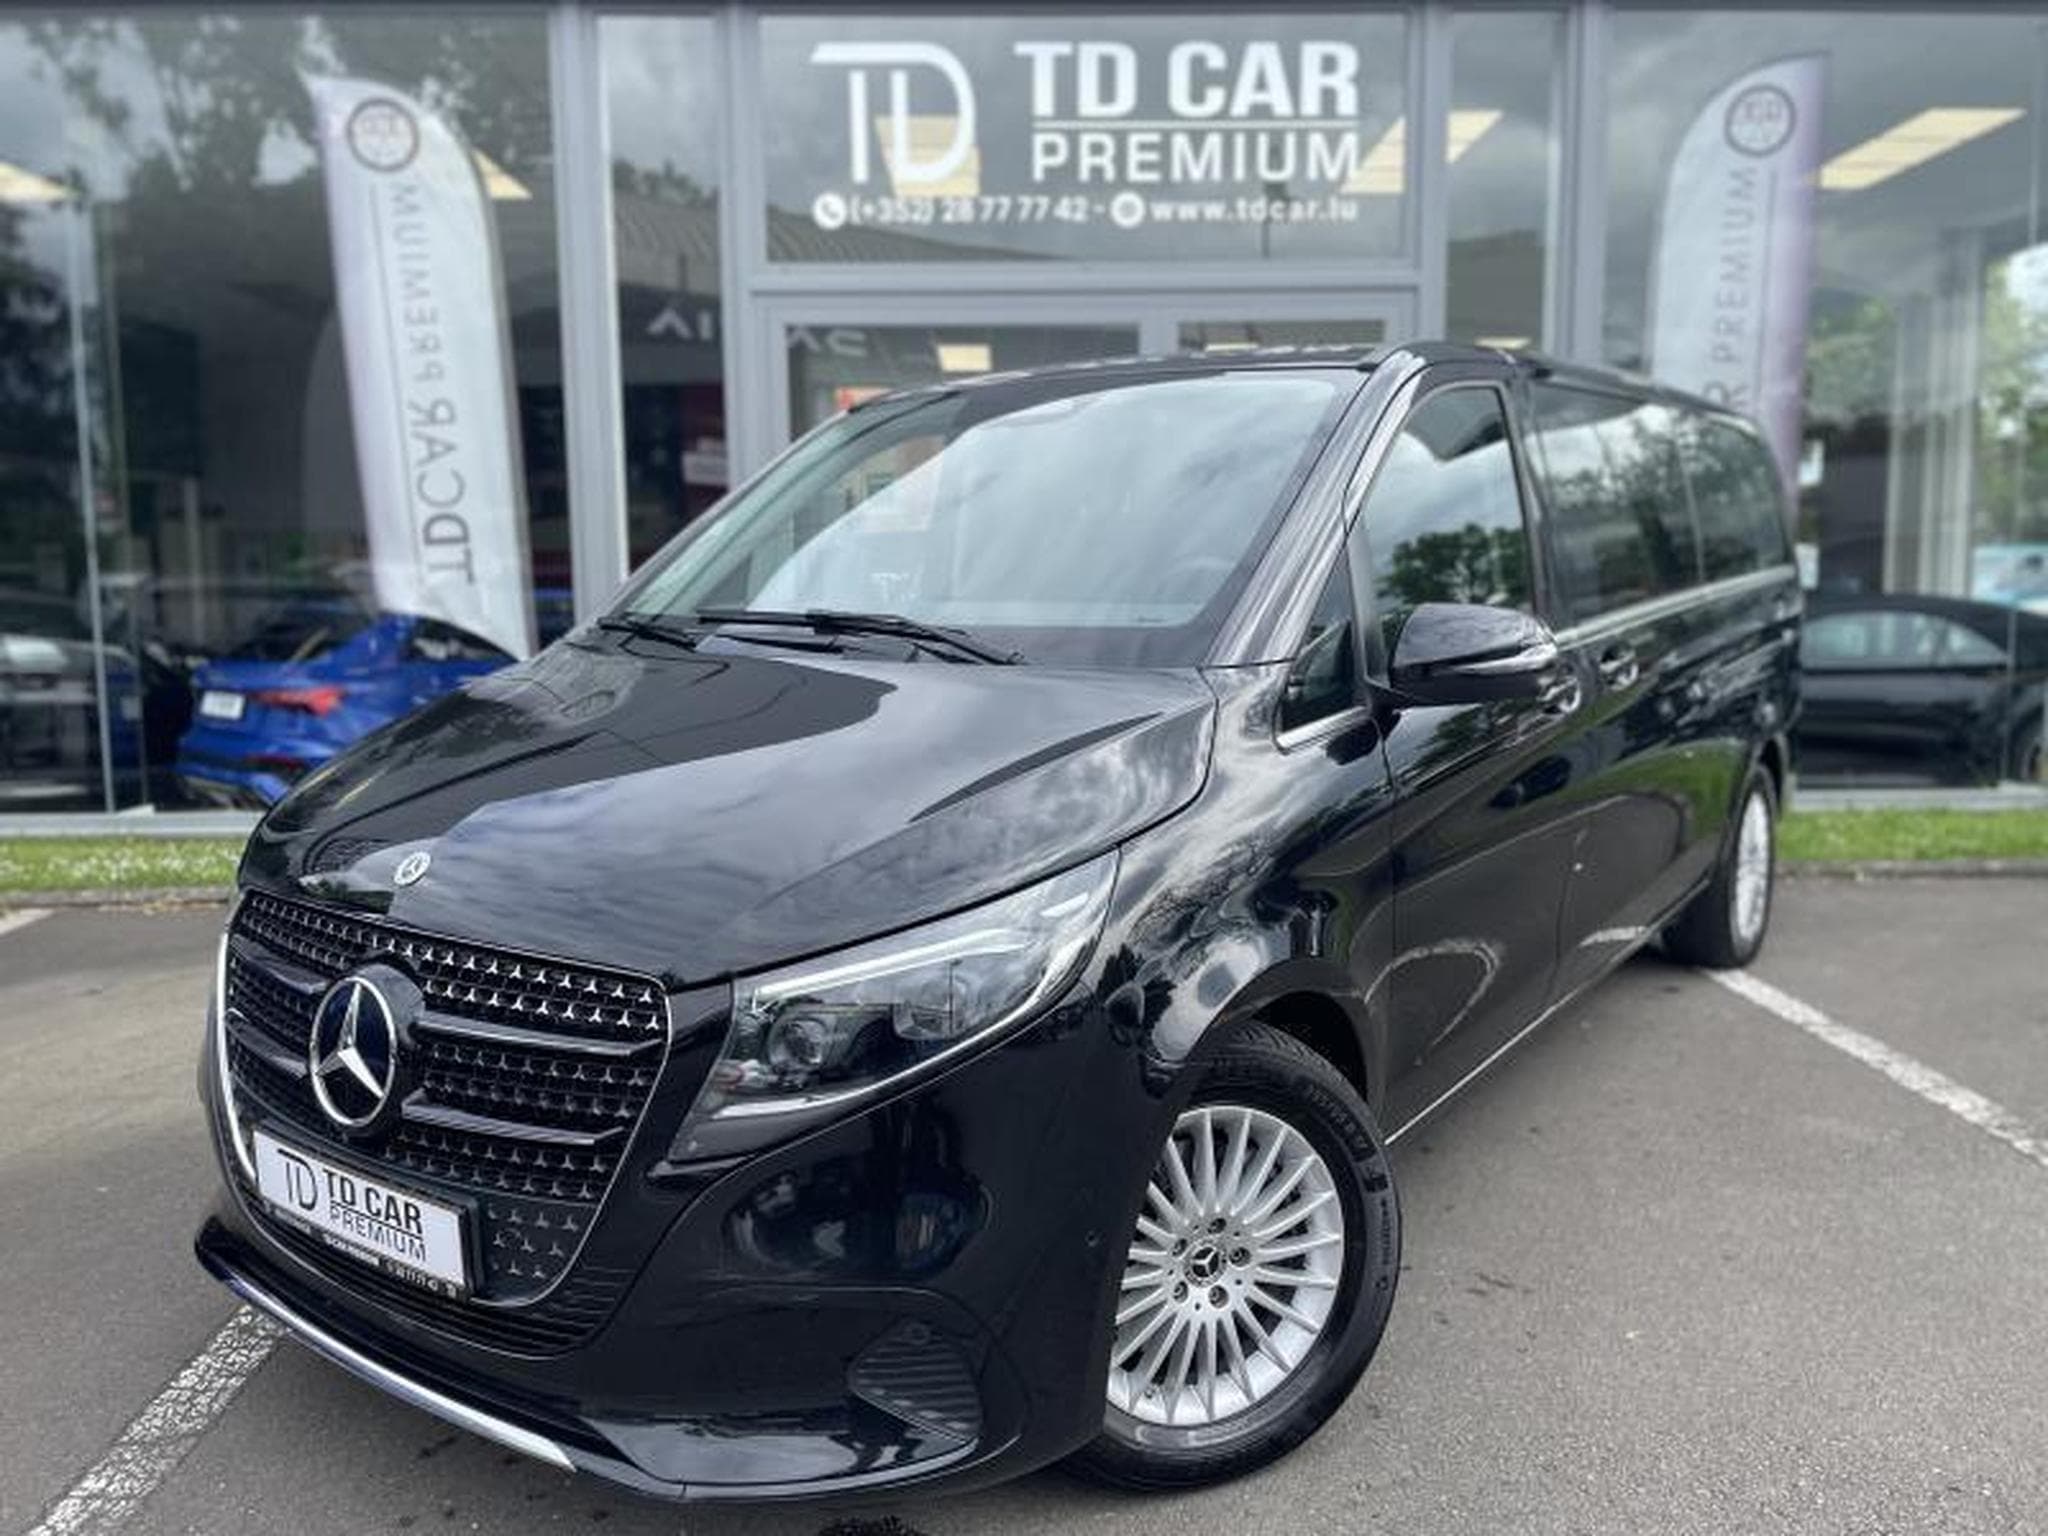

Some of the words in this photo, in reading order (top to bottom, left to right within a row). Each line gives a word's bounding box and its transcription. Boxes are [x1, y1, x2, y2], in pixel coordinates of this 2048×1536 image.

[1014, 41, 1138, 118] TD
[1168, 41, 1359, 118] CAR
[1032, 131, 1359, 184] PREMIUM
[1053, 196, 1089, 224] 42
[1151, 197, 1358, 222] www.tdcar.lu
[1712, 165, 1758, 363] PREMIUM
[322, 1168, 356, 1207] TD
[364, 1187, 423, 1235] CAR
[329, 1204, 427, 1263] PREMIUM
